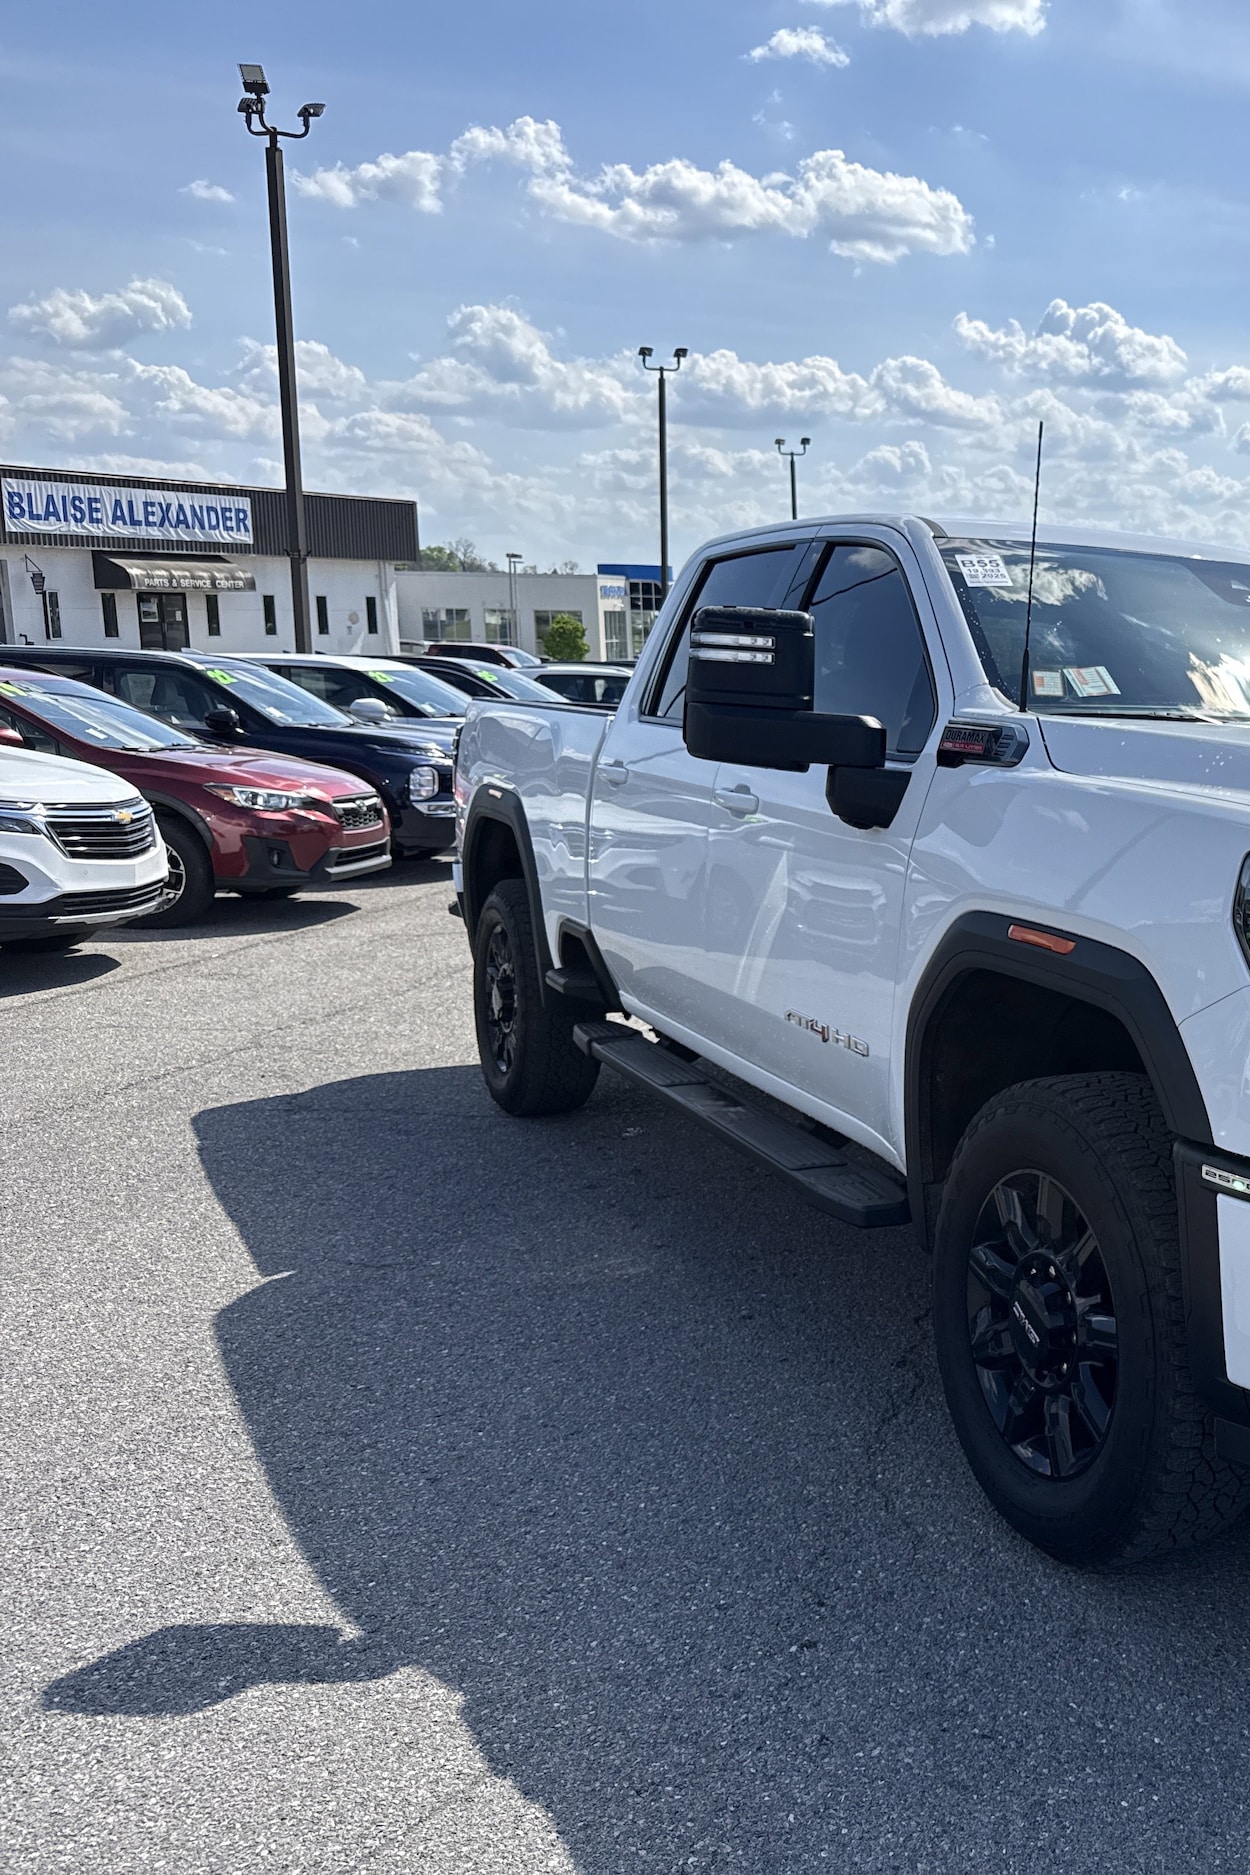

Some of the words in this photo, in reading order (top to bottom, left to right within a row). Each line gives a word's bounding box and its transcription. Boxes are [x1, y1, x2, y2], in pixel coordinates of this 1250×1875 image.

[7, 491, 102, 524] BLAISE
[111, 498, 250, 533] ALEXANDER
[961, 559, 1000, 567] B55
[144, 578, 170, 588] PARTS
[172, 578, 178, 588] &
[180, 578, 212, 588] SERVICE
[215, 579, 244, 589] CENTER
[945, 729, 986, 744] DURAMAX
[784, 1007, 830, 1043] AT4
[832, 1027, 870, 1058] HD
[1013, 1300, 1041, 1348] GMC
